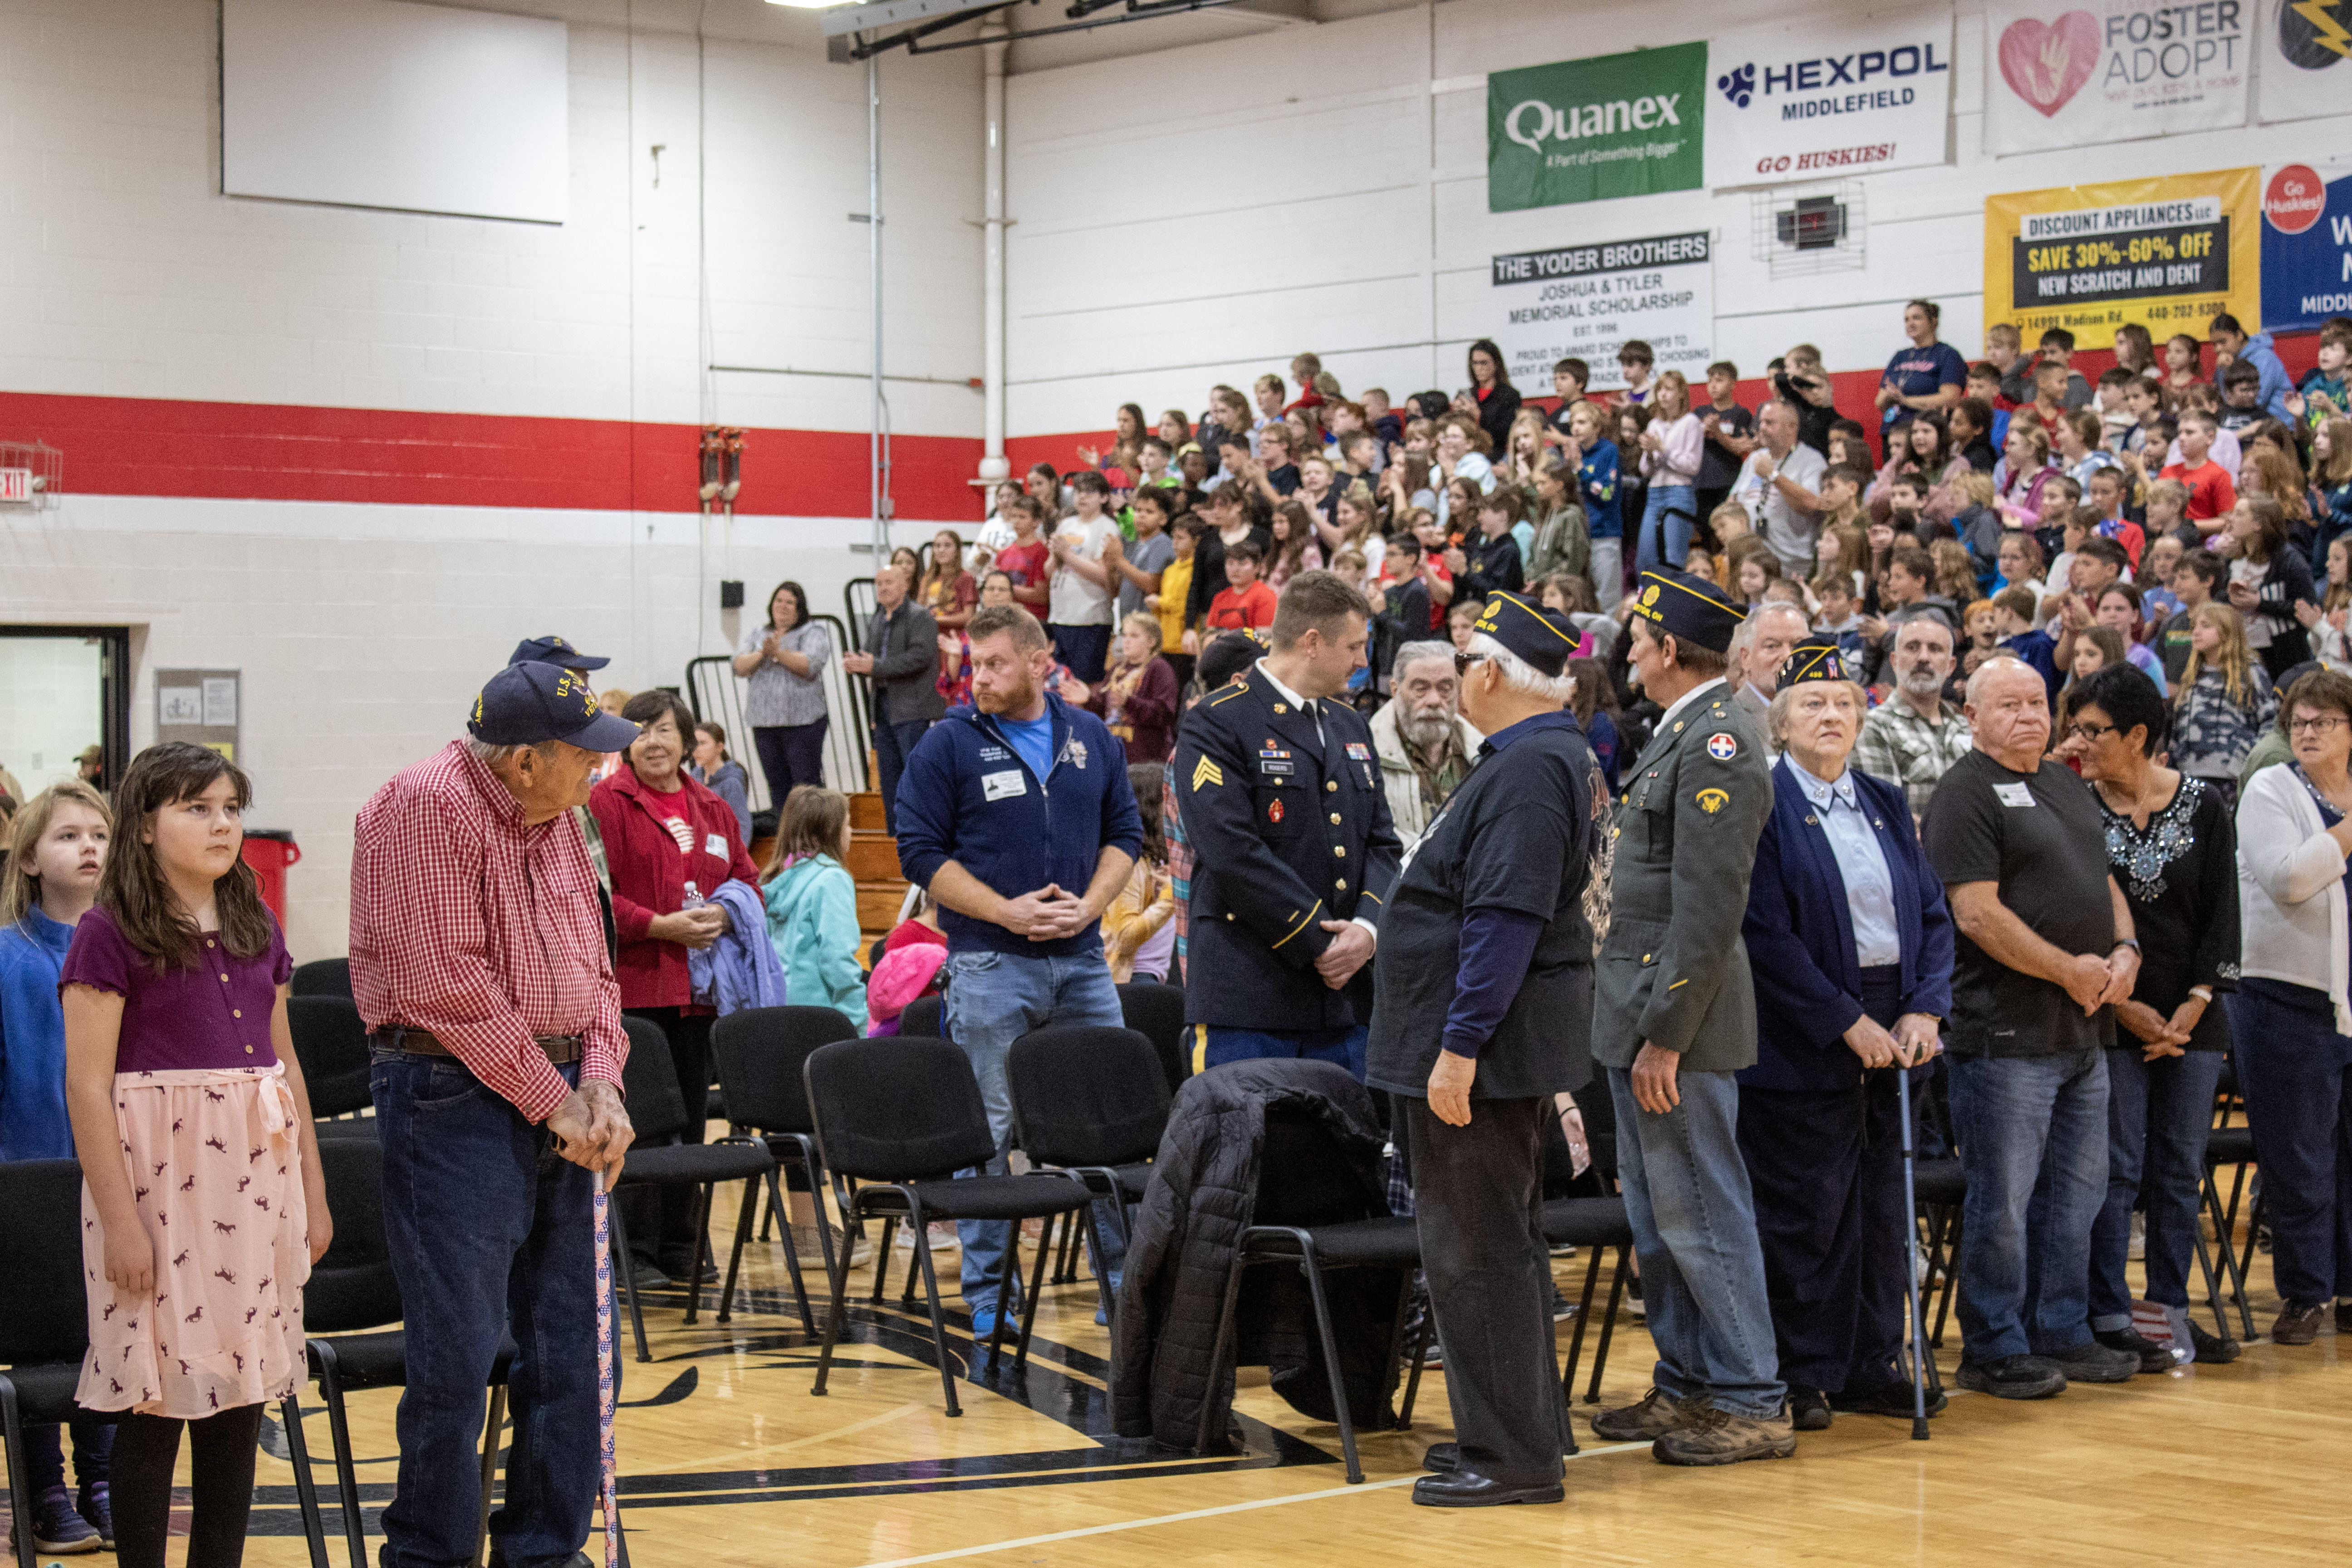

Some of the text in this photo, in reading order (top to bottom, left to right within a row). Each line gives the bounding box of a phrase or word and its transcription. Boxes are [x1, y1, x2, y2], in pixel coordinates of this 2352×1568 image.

[2107, 0, 2240, 48] FOSTER
[1764, 44, 1947, 95] HEXPOL
[2103, 35, 2241, 88] ADOPT
[1781, 88, 1915, 121] MIDDLEFIELD
[1505, 93, 1680, 154] Quanex
[1555, 153, 1577, 167] Part
[1578, 150, 1589, 166] of
[1590, 147, 1644, 164] Something
[1646, 142, 1679, 159] Bigger
[1756, 143, 1896, 174] GO HUSKIES!
[2283, 180, 2306, 197] Go
[2030, 212, 2099, 237] DISCOUNT
[2104, 204, 2193, 228] APPLIANCES
[1497, 236, 1707, 280] THE YODER BROTHERS
[2028, 232, 2213, 272] SAVE 30%-60% OFF
[1539, 273, 1662, 302] JOSHUA & TYLER
[2038, 262, 2202, 297] NEW SCRATCH AND DENT
[1509, 291, 1693, 324] MEMORIAL SCHOLARSHIP
[1516, 348, 1548, 361] PROUD
[1550, 346, 1562, 358] TO
[1565, 343, 1597, 356] AWARD
[1674, 334, 1688, 347] TO
[0, 472, 25, 498] XIT
[557, 678, 571, 697] U.S.
